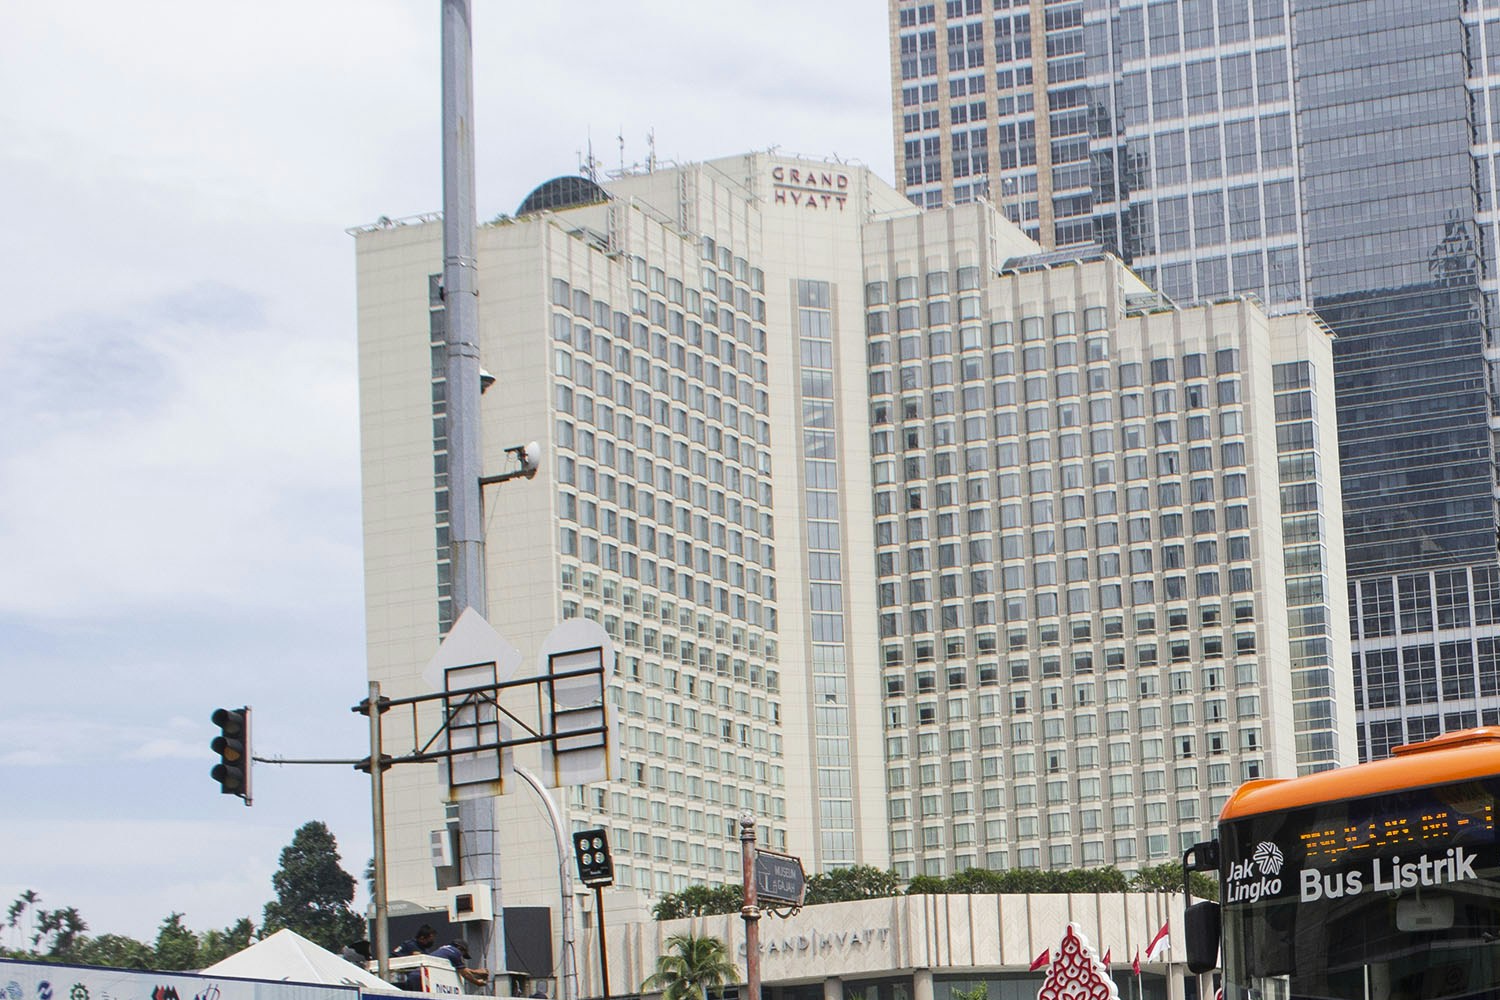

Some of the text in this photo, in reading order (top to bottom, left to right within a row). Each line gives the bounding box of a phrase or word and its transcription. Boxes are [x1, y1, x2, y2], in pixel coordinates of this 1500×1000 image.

[772, 166, 848, 188] GRAND
[775, 189, 847, 211] HYATT
[774, 865, 796, 878] MUSEUM
[1226, 858, 1255, 882] Jak
[1300, 847, 1478, 903] Bus Listrik
[1227, 876, 1282, 903] Lingko
[820, 928, 889, 949] HYATT
